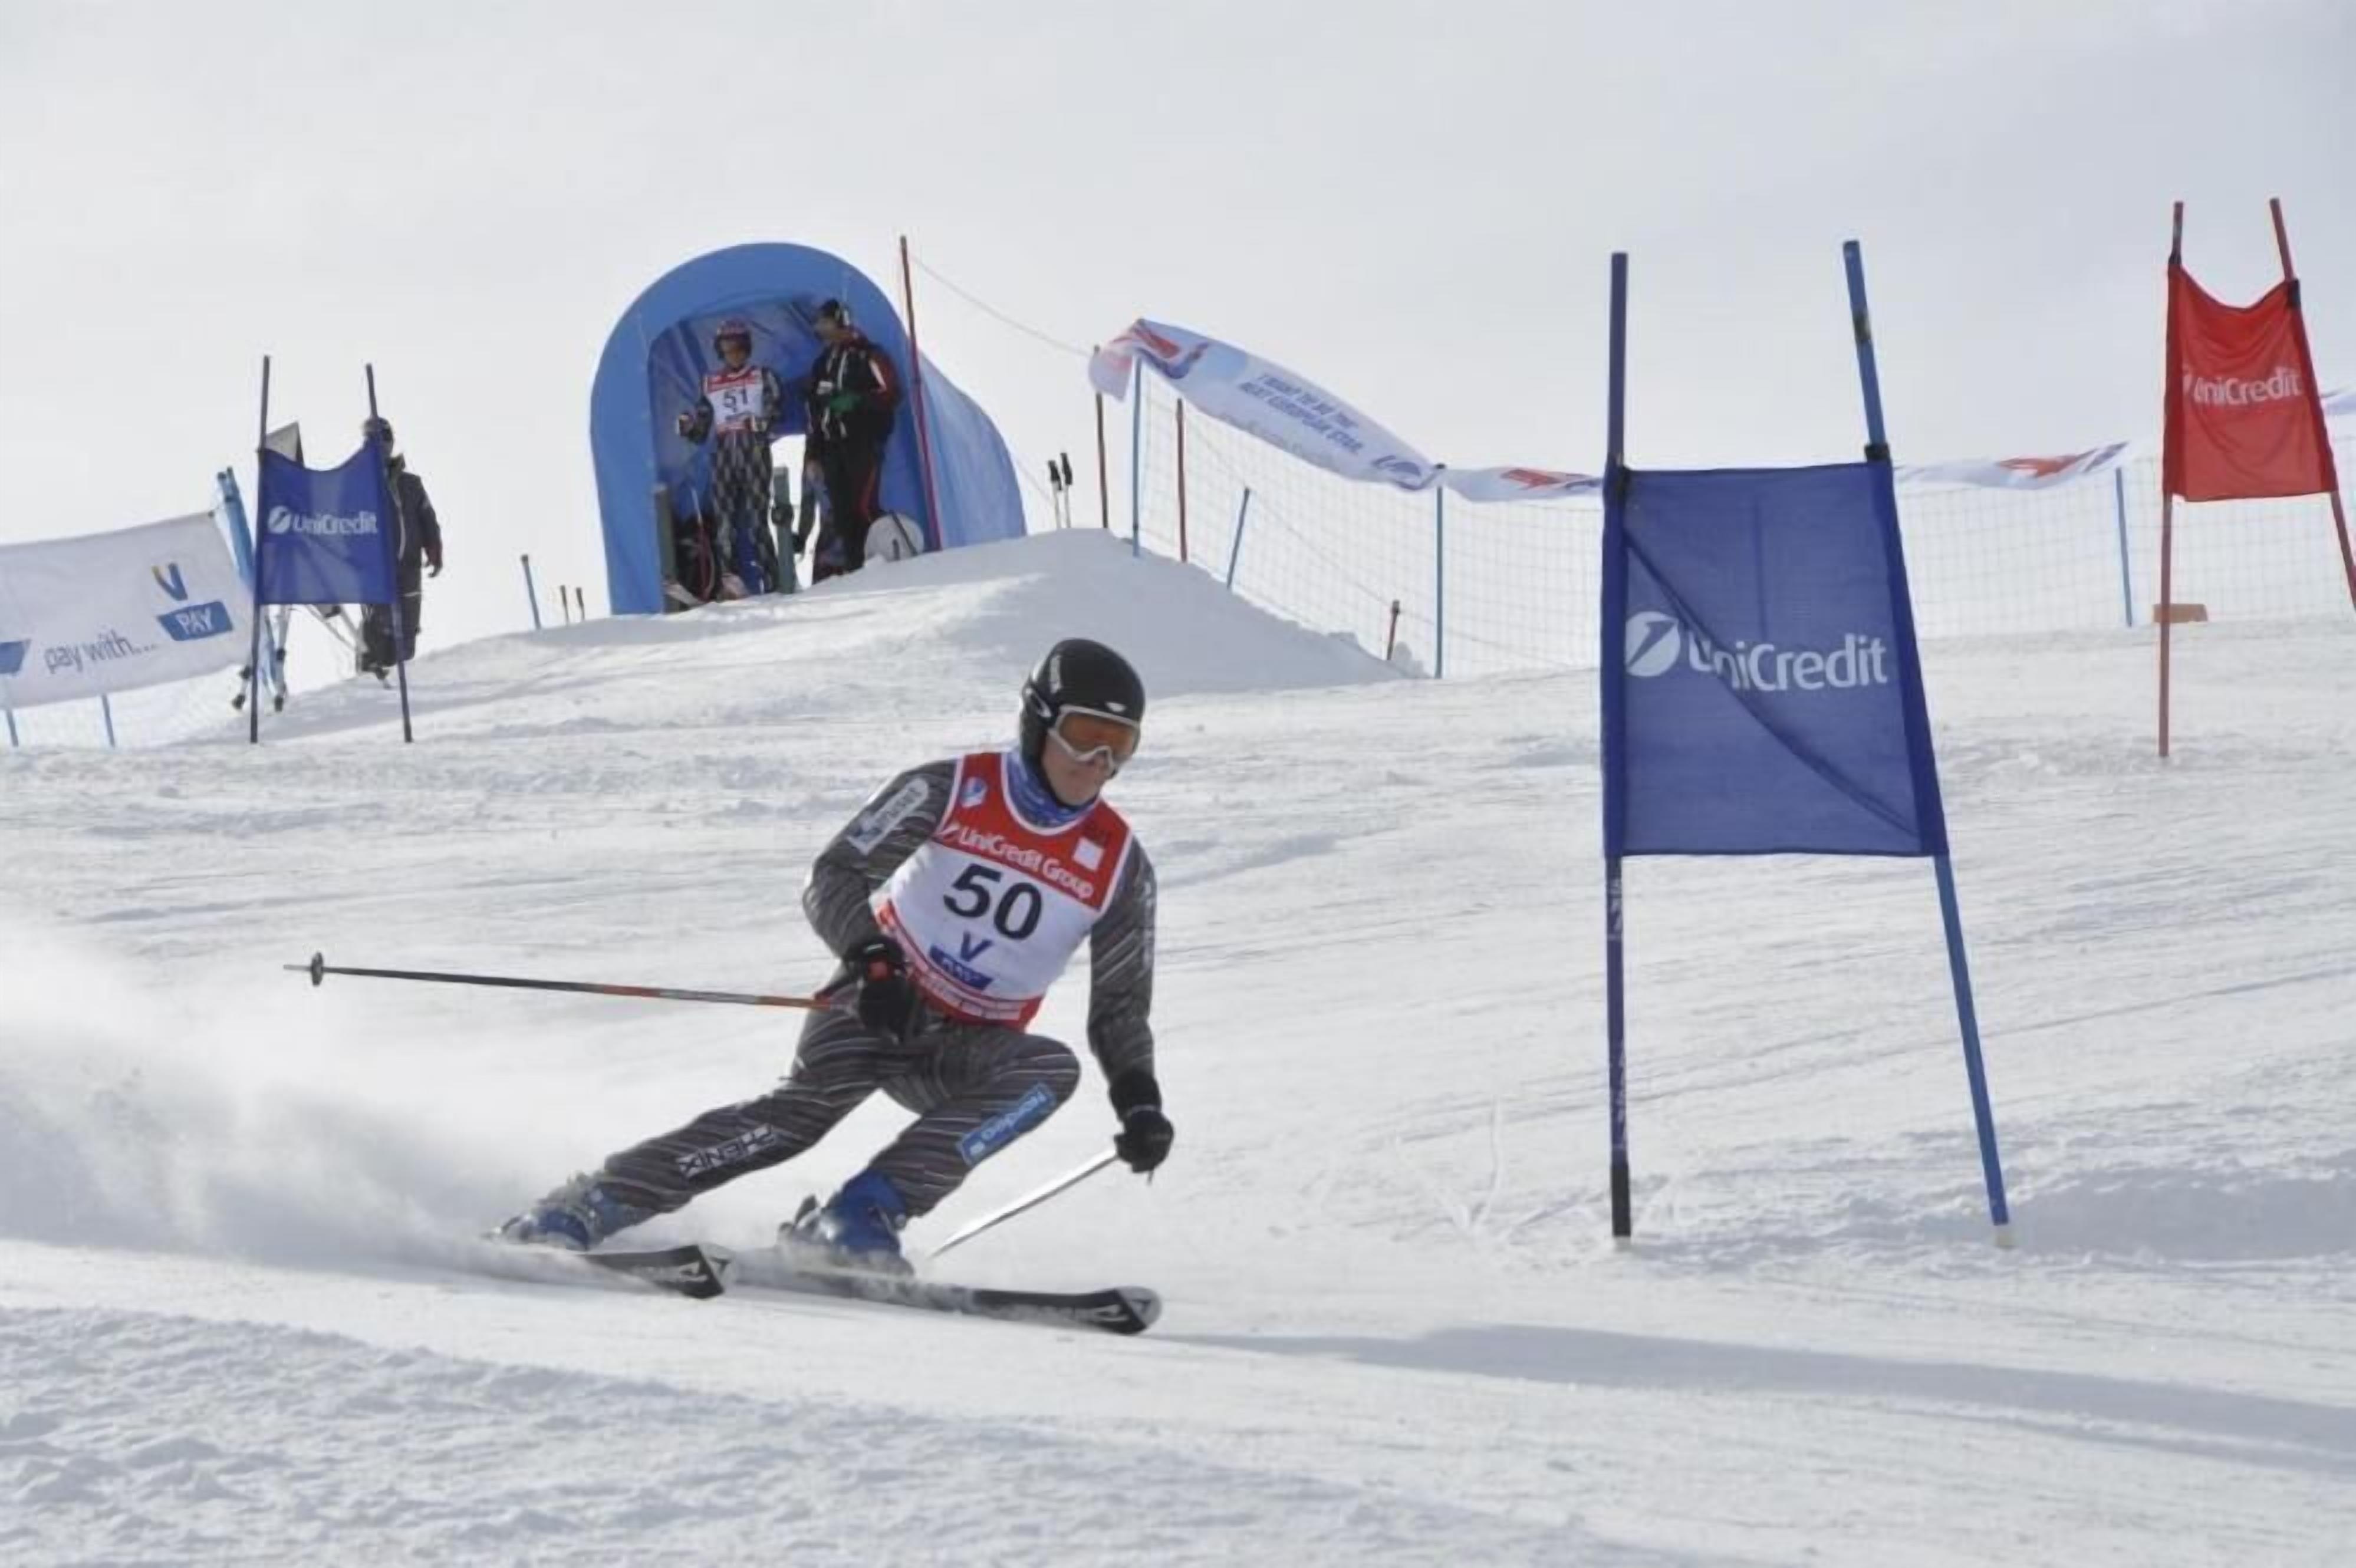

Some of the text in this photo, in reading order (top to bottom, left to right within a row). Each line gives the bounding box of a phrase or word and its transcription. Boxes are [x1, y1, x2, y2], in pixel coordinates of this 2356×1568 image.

[722, 390, 748, 408] 51
[2194, 367, 2301, 406] UniCredit
[293, 510, 378, 535] UniCredit
[176, 608, 213, 634] PAY
[44, 646, 83, 674] pay
[1687, 632, 1888, 691] UniCredit
[959, 826, 1094, 899] UniCredit Group
[943, 863, 1042, 941] 50
